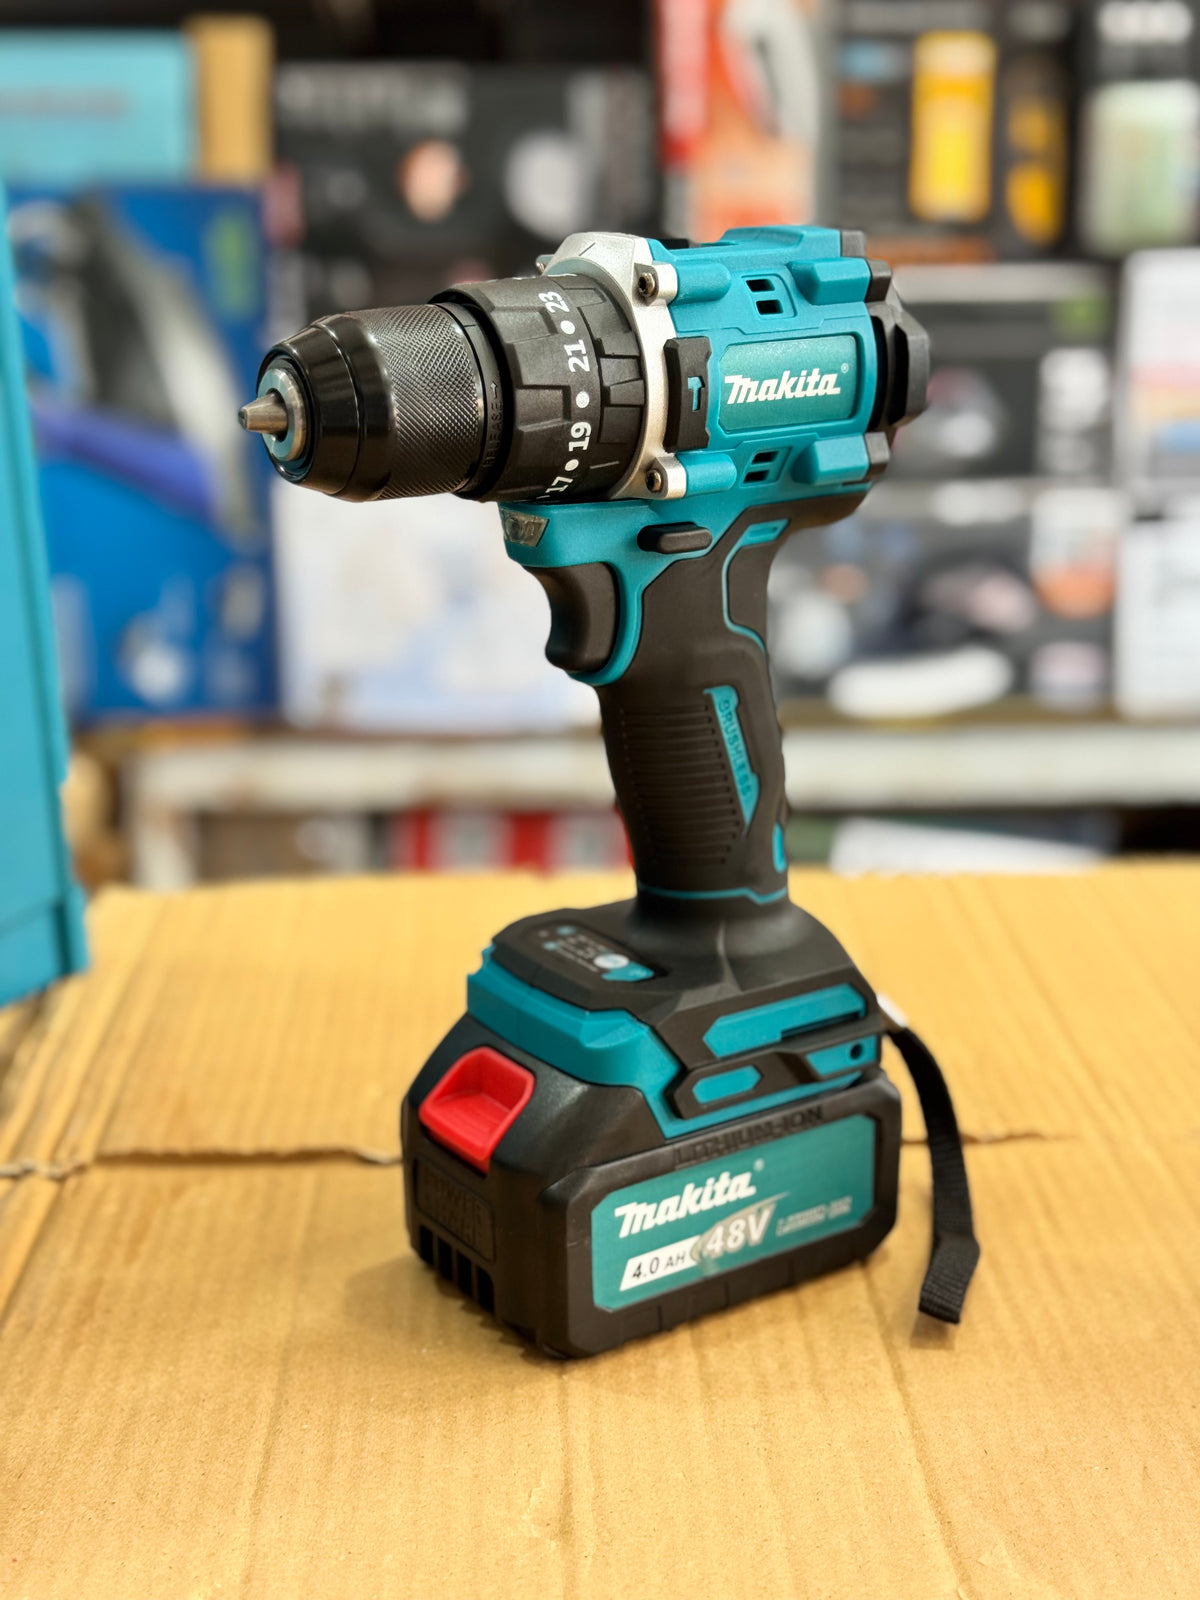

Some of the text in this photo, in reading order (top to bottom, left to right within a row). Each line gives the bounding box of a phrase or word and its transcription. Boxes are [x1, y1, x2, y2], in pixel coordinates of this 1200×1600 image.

[538, 291, 570, 313] 23
[563, 339, 590, 373] 21
[568, 421, 592, 451] 19
[674, 1105, 823, 1167] LITHIUM-ION
[632, 1256, 660, 1279] 4.0
[665, 1251, 686, 1270] AH
[703, 1202, 776, 1259] 48V
